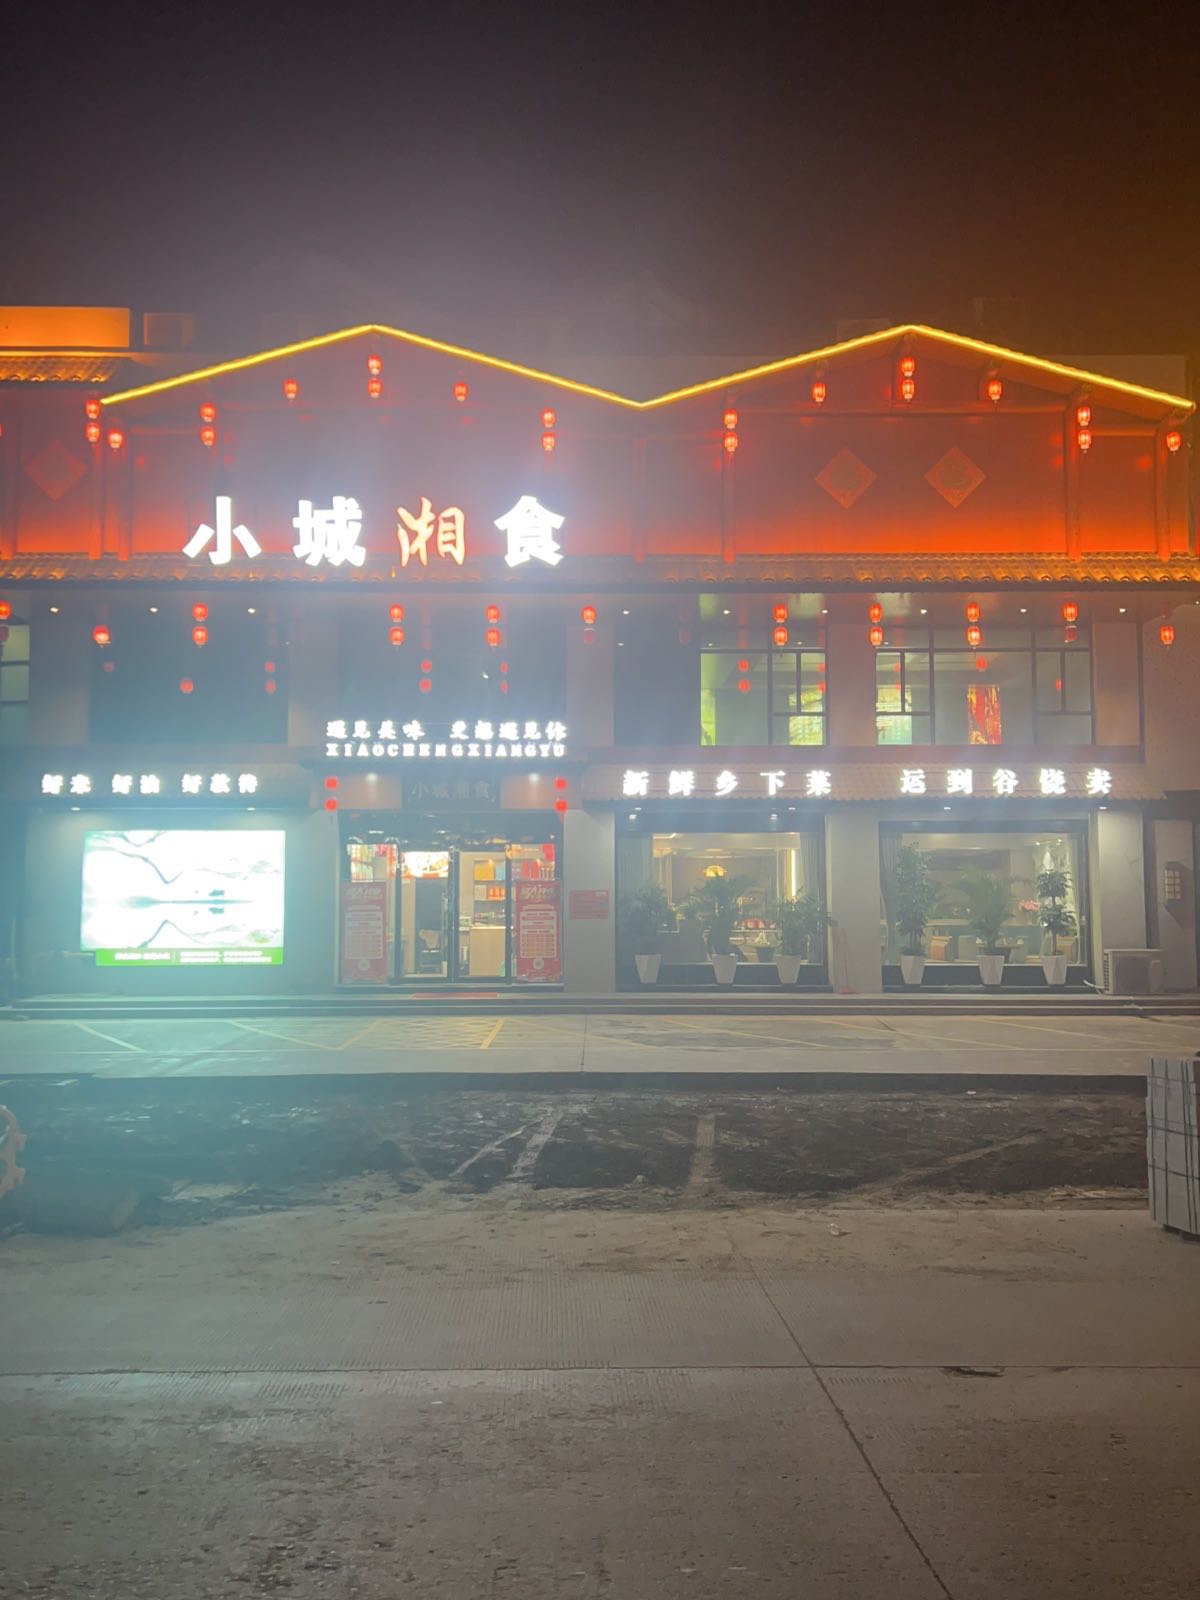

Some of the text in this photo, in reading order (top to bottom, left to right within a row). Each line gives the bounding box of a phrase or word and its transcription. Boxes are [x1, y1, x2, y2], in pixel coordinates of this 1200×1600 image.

[183, 495, 565, 568] 小城湘食
[326, 741, 565, 758] XIAOCHENGXIANGYU
[622, 769, 832, 797] 新鲜乡下菜
[900, 768, 1112, 796] 运到谷饶卖
